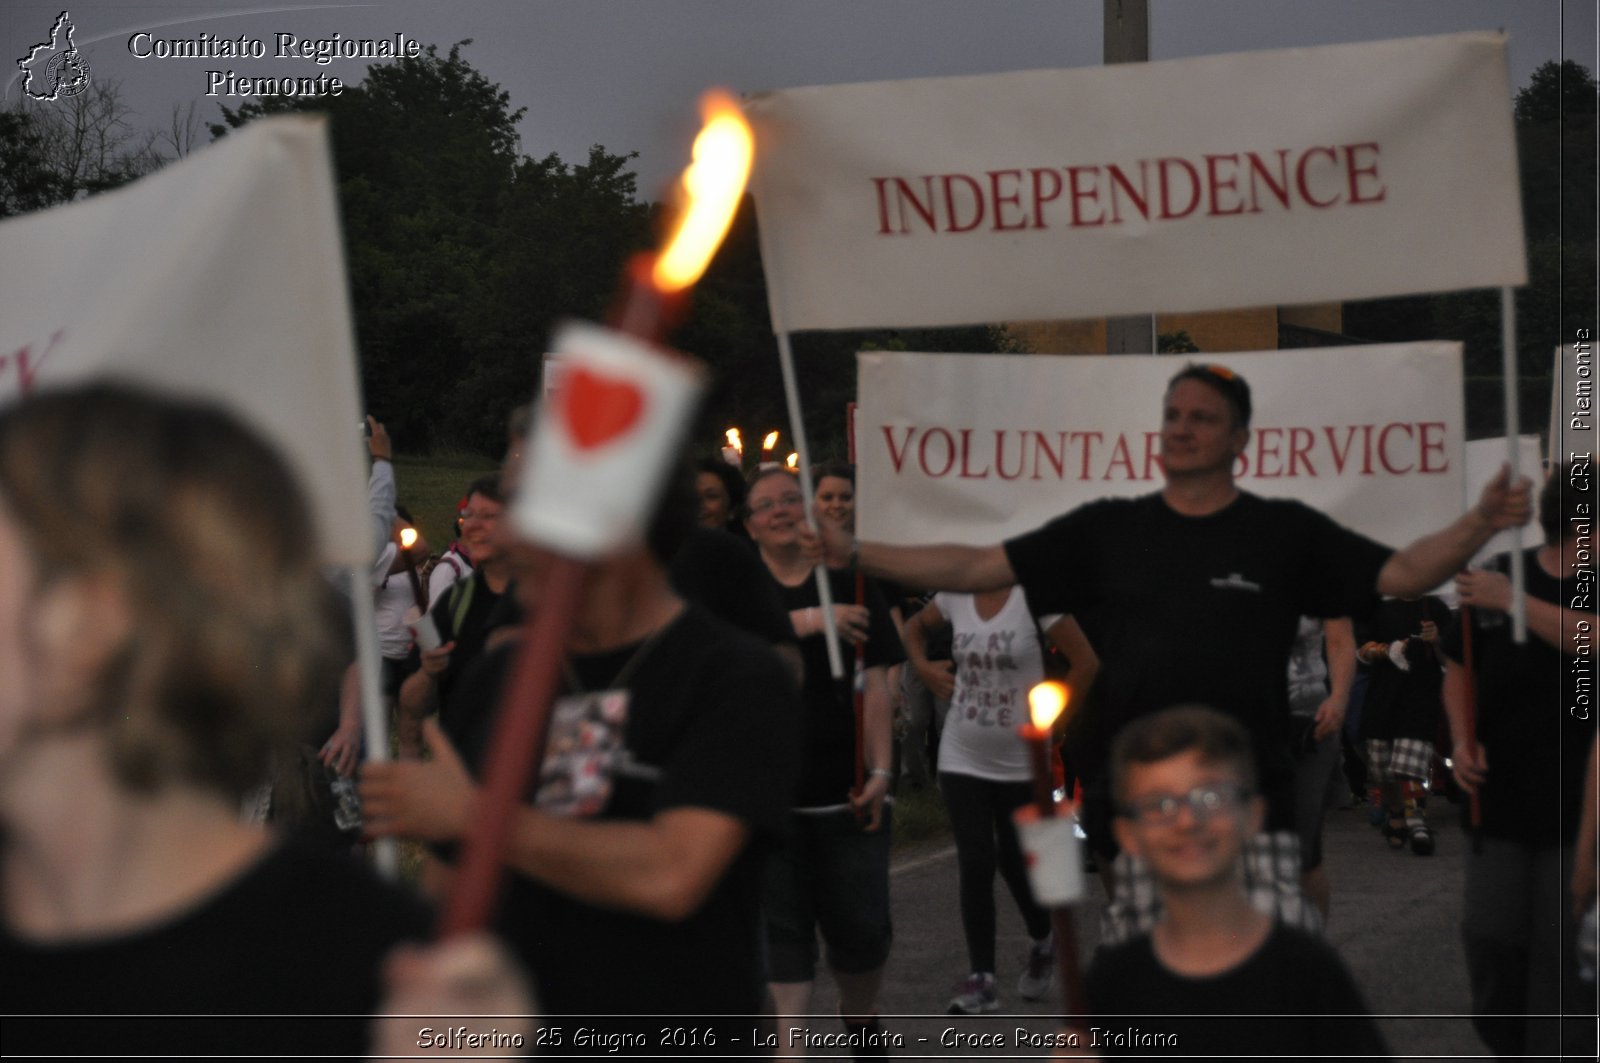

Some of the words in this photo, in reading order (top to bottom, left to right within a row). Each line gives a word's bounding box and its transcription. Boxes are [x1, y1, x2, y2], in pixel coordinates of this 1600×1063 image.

[869, 142, 1387, 236] INDEPENDENCE
[879, 425, 1167, 482] VOLUNTAR
[953, 630, 1016, 654] EVRY
